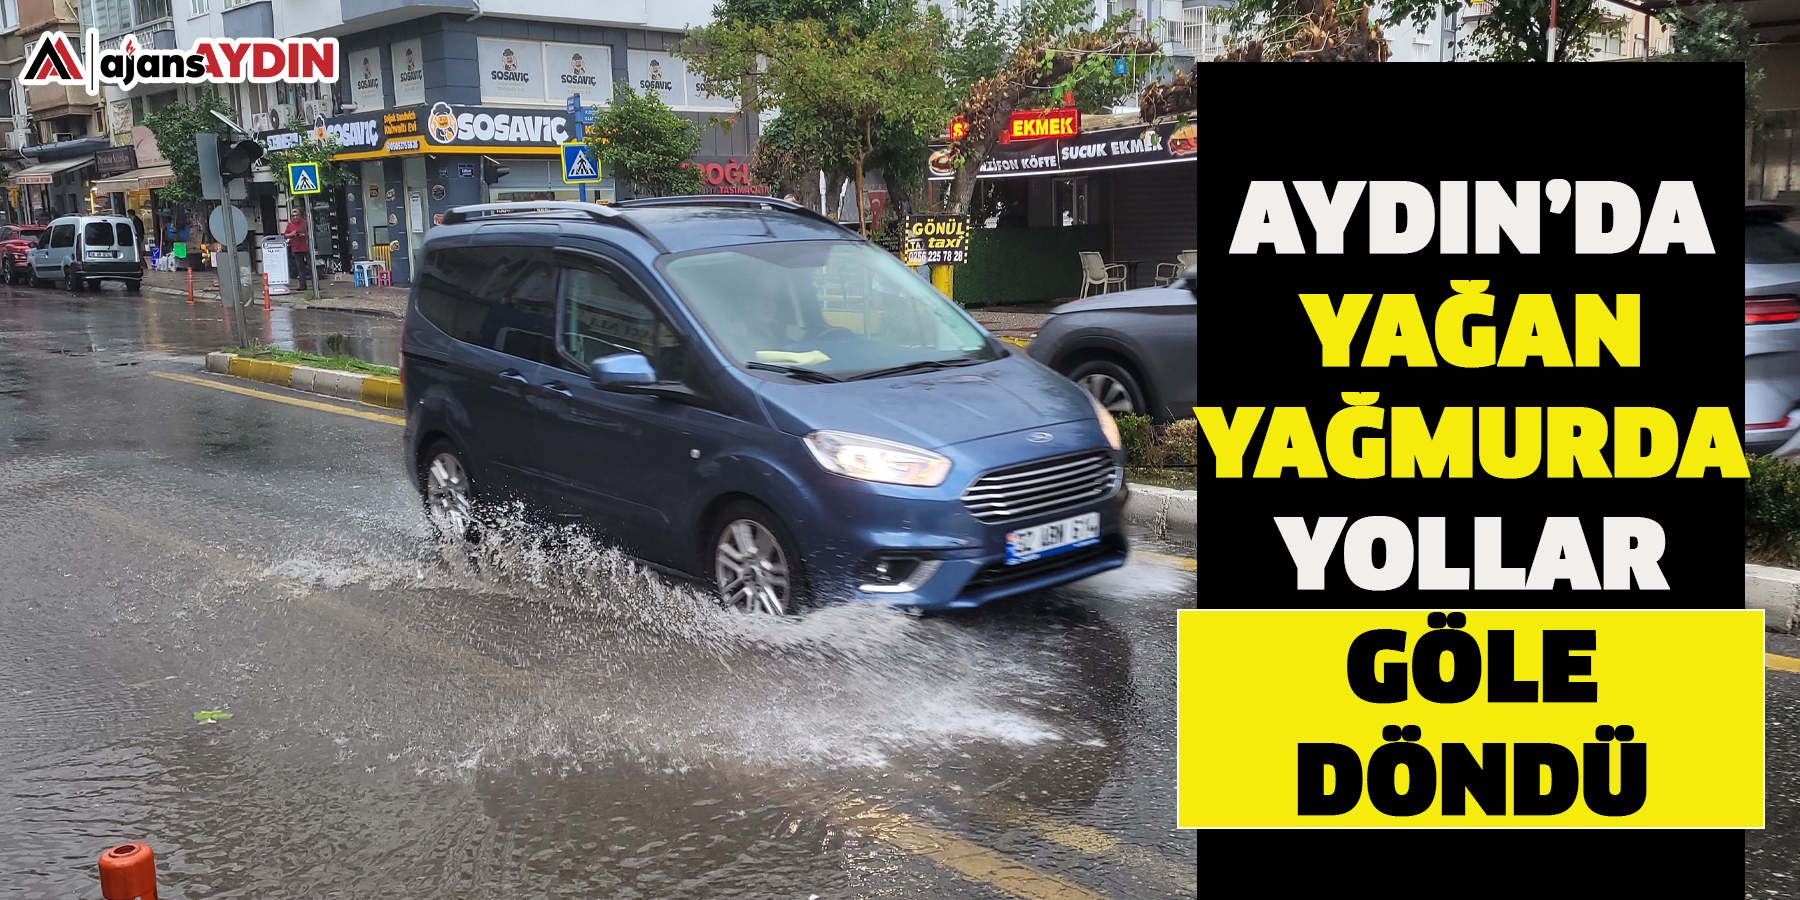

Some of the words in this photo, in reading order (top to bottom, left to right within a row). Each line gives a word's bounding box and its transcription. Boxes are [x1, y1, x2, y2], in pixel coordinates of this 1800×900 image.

[1013, 117, 1075, 137] EKMEK
[1061, 143, 1107, 160] SUCUK
[1022, 153, 1057, 169] KÖFTE
[912, 218, 965, 235] GÖNÜL
[928, 236, 963, 249] taxi
[908, 251, 926, 262] 0256
[928, 251, 941, 262] 225
[943, 250, 952, 262] 78
[953, 250, 963, 262] 28
